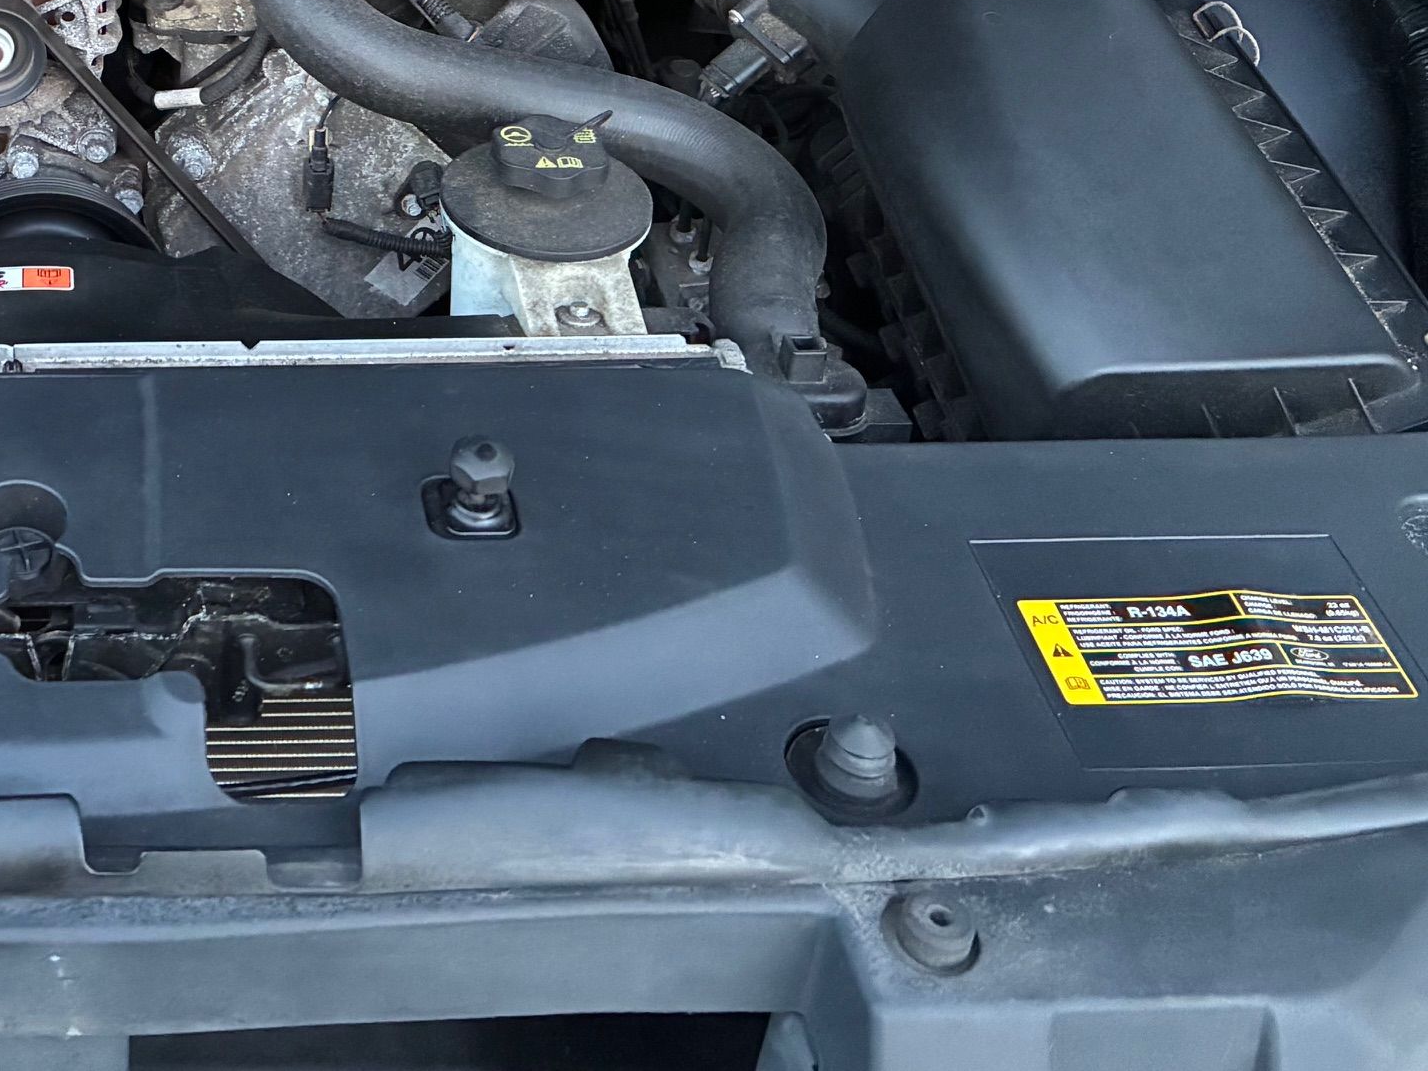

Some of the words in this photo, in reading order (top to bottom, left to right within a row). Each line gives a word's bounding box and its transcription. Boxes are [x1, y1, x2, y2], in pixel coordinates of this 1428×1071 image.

[1127, 605, 1191, 618] R-134A
[1032, 615, 1059, 626] A/C
[1188, 653, 1229, 668] SAE
[1231, 648, 1273, 664] J639
